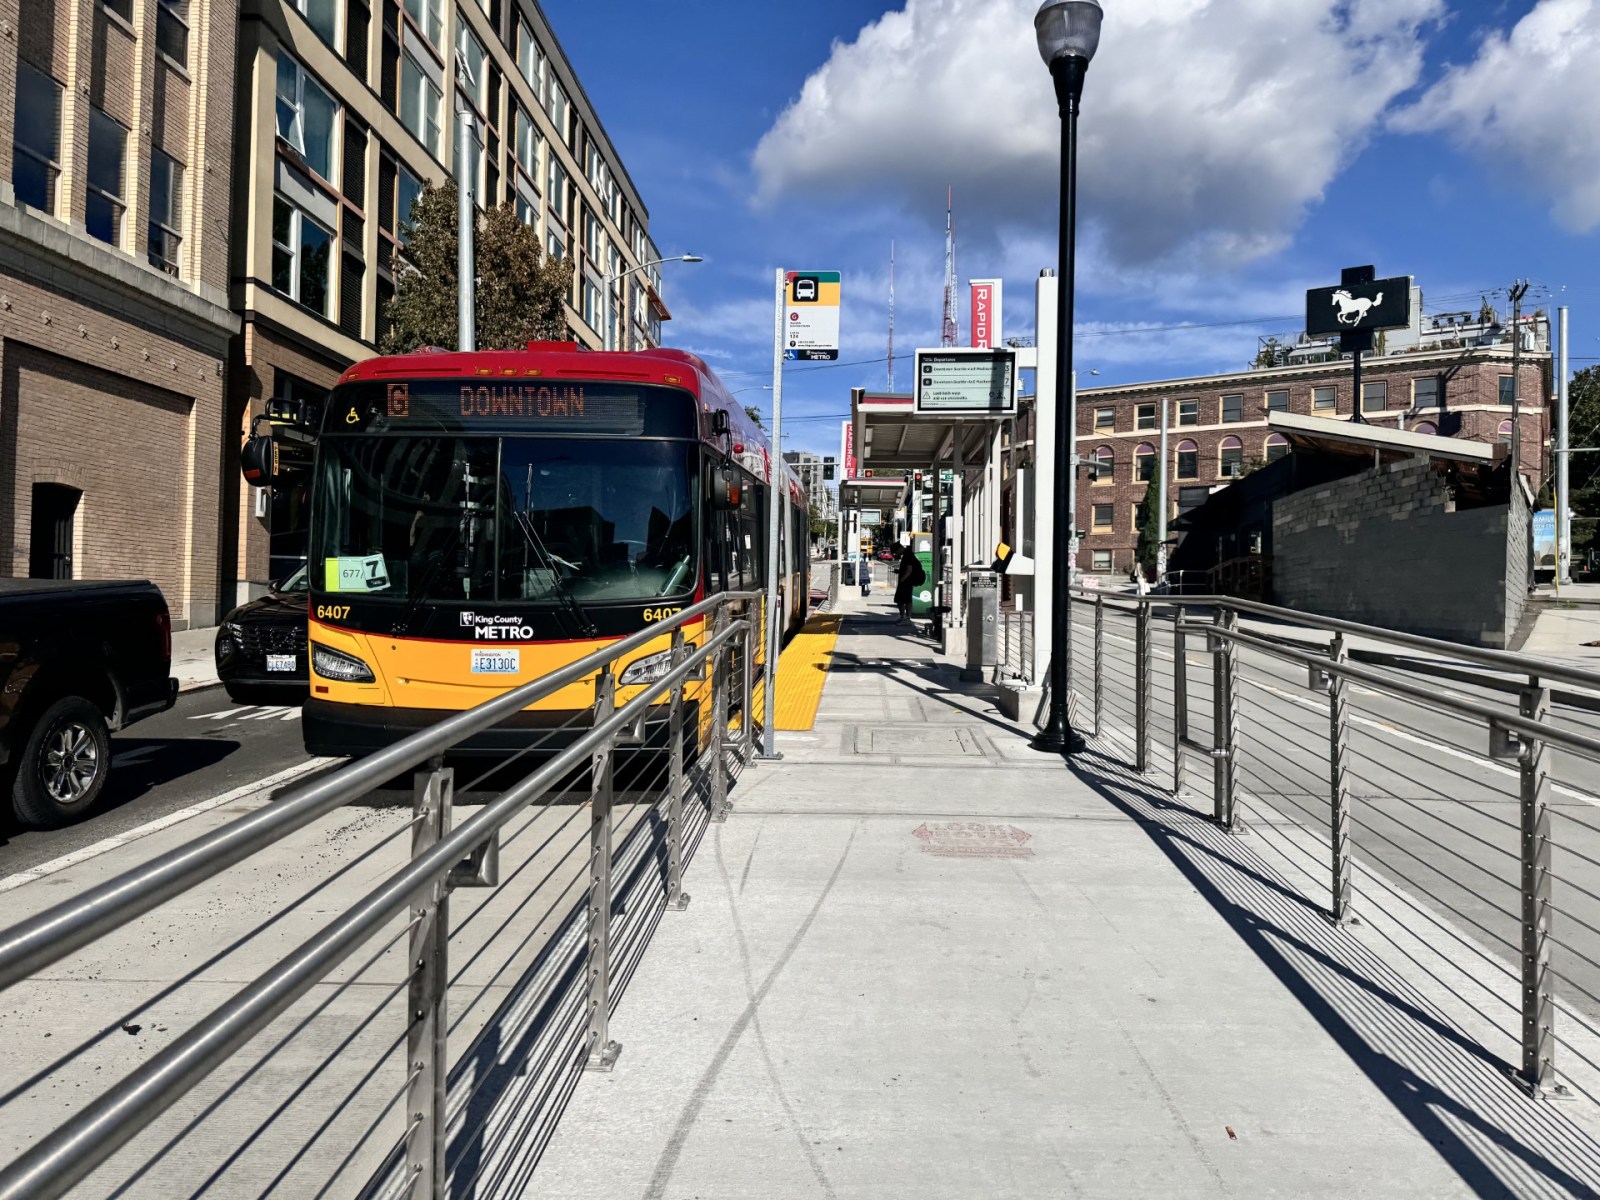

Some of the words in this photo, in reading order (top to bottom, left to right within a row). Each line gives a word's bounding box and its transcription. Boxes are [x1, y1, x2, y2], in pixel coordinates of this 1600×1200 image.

[388, 384, 408, 416] G
[460, 386, 584, 416] DOWNTOWN
[365, 560, 379, 577] 7
[317, 605, 351, 619] 6407
[475, 615, 493, 625] King
[494, 615, 523, 625] County
[475, 626, 534, 639] METRO
